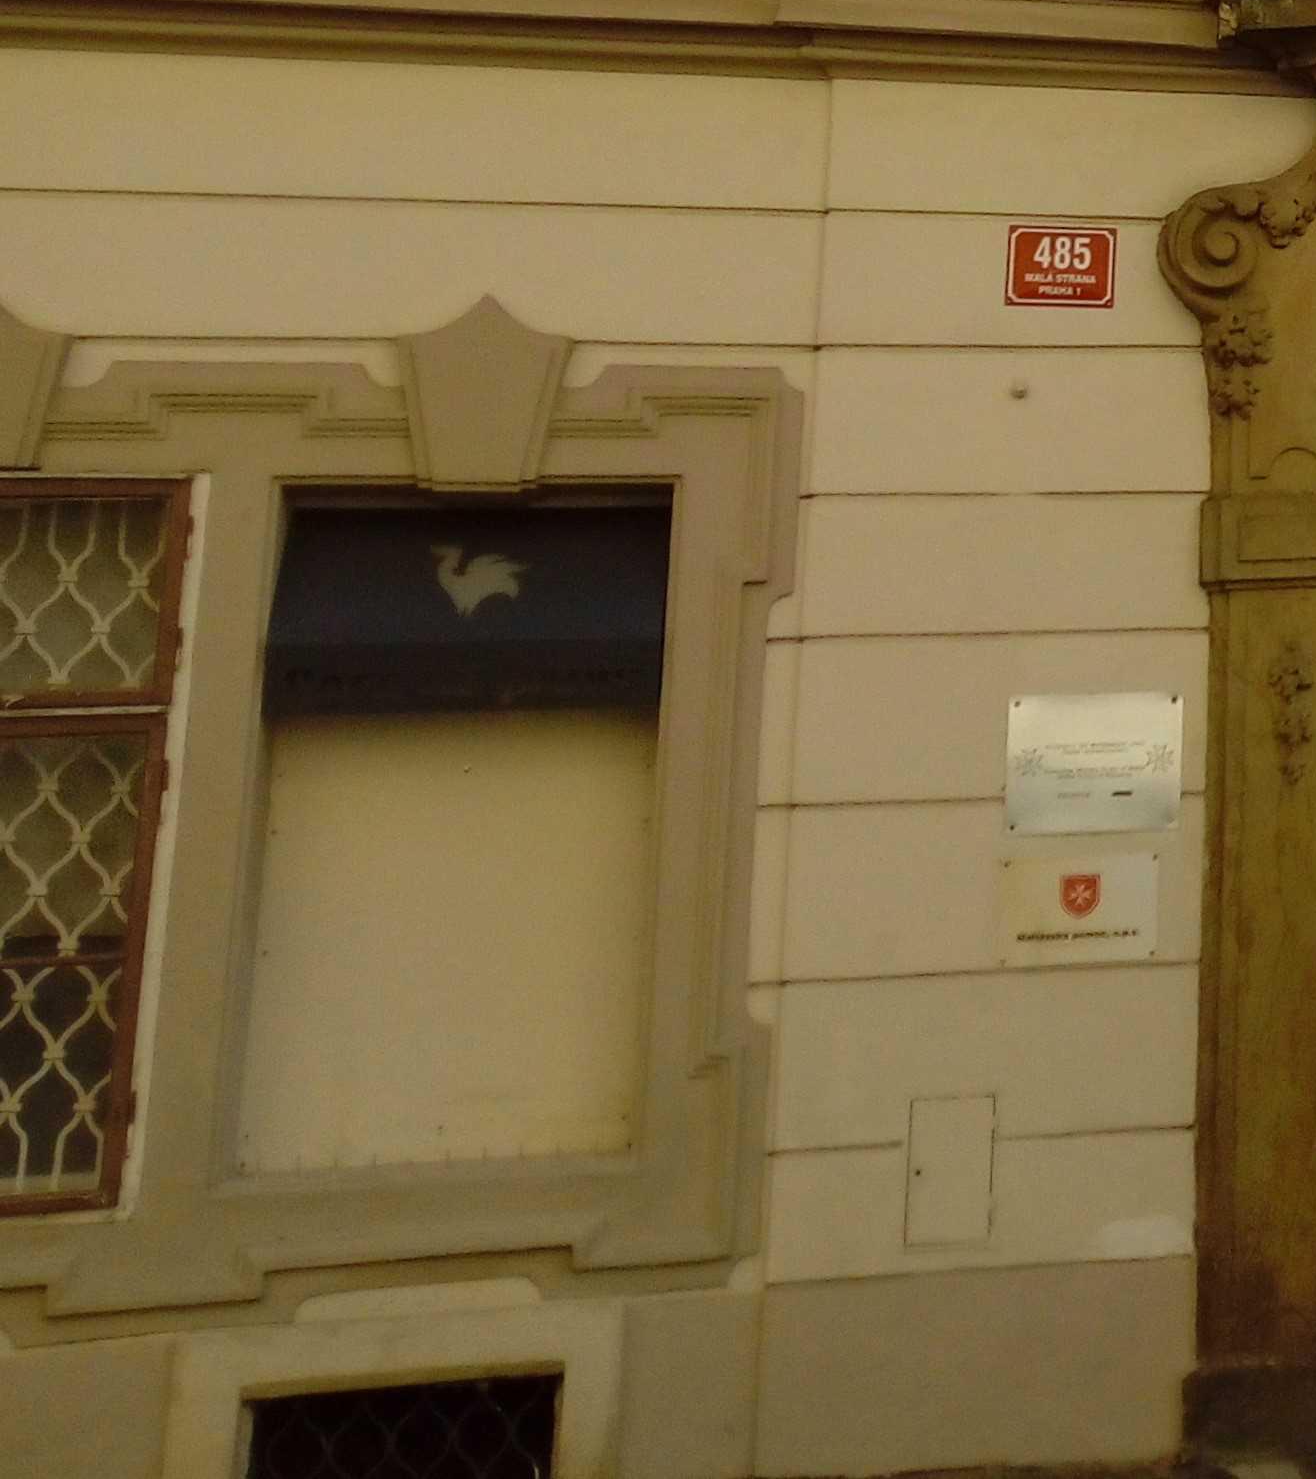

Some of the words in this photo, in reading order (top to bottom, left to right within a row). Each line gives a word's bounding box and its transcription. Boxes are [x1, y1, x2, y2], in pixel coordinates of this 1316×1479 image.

[1034, 236, 1092, 270] 485
[1025, 272, 1053, 283] MALÁ
[1055, 274, 1096, 283] STRANA
[1038, 285, 1074, 296] PRAHA
[1076, 287, 1082, 297] 1
